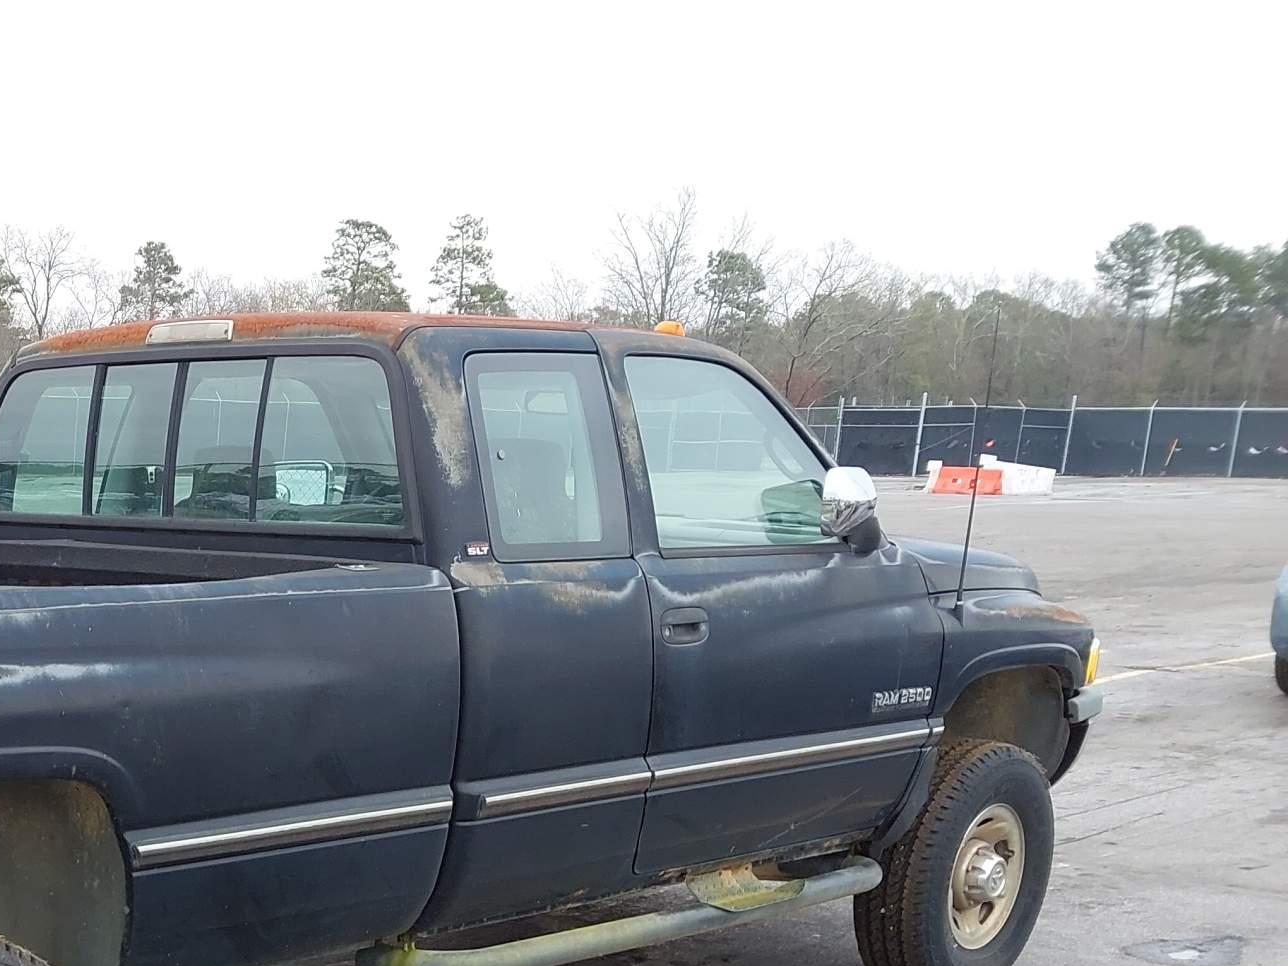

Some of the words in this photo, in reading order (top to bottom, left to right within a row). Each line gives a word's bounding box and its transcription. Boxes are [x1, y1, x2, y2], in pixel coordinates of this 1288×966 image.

[467, 546, 489, 556] SLT
[874, 690, 900, 708] RAM
[900, 686, 933, 704] 2500
